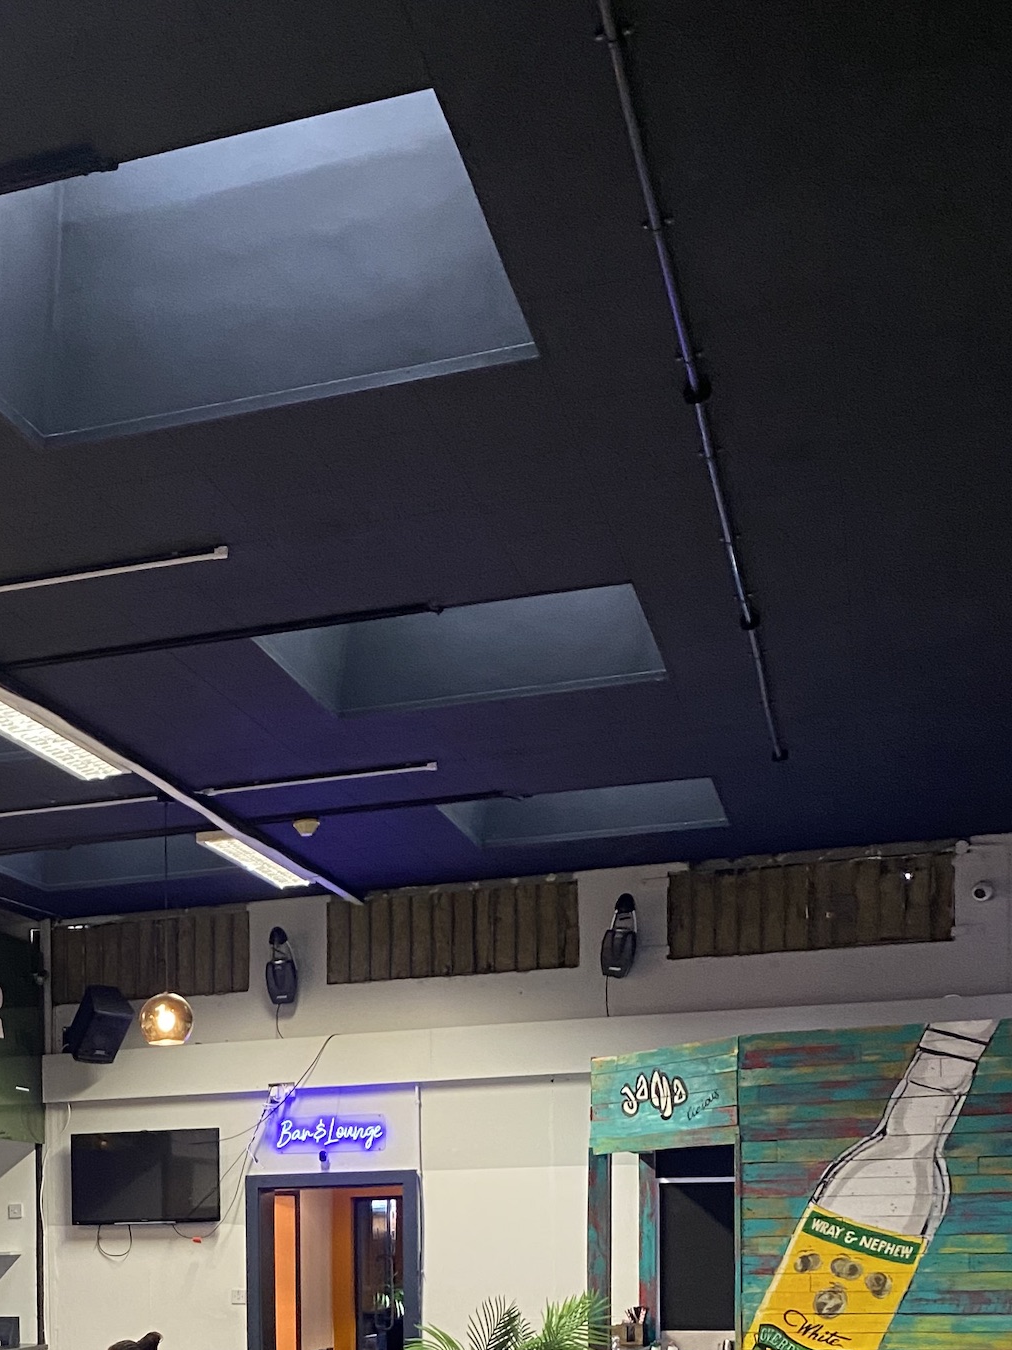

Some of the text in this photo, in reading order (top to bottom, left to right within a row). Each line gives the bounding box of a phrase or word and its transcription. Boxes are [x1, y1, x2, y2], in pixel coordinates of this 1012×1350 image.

[811, 1218, 914, 1259] WRAY & NEPHEW
[783, 1309, 852, 1348] White
